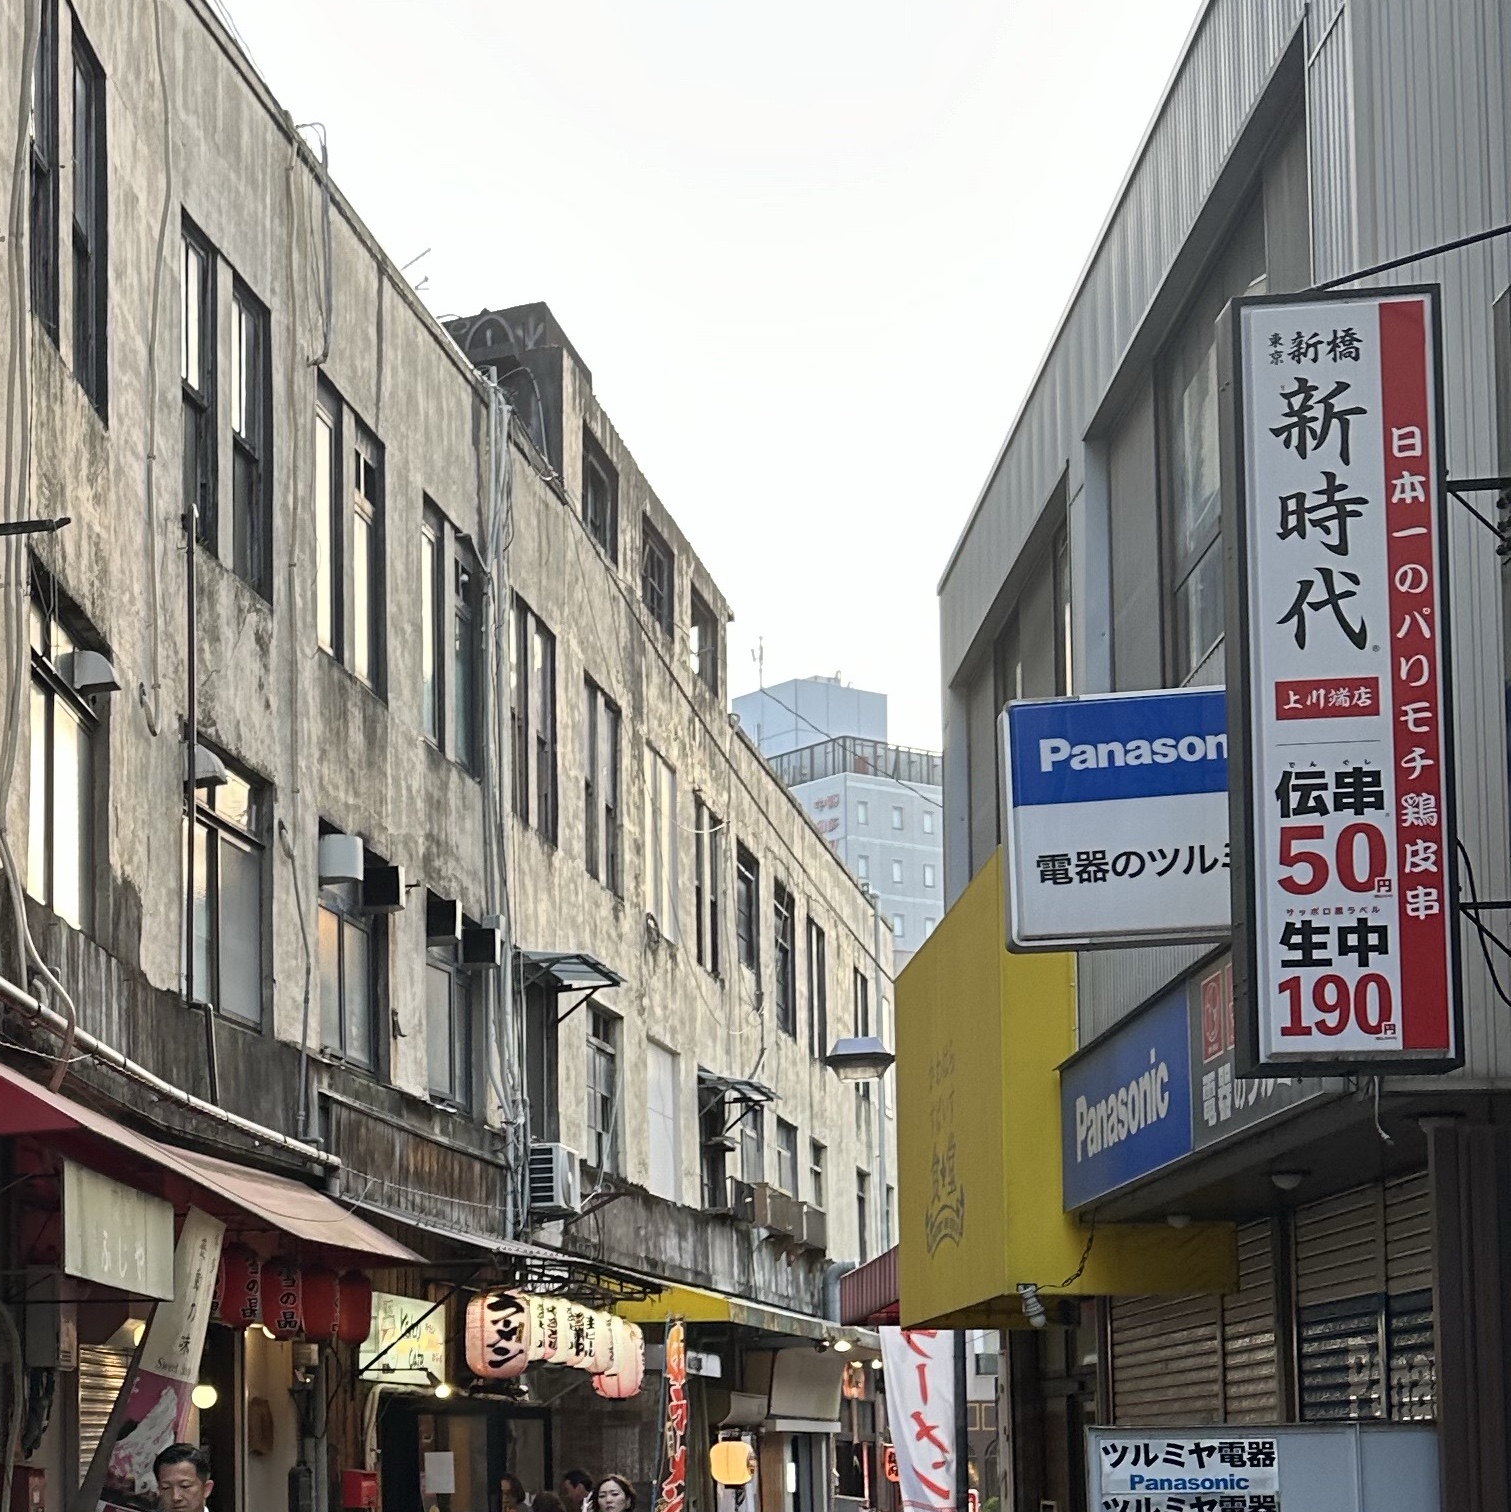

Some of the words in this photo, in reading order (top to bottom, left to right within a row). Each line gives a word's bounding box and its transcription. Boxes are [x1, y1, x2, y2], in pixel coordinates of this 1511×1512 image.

[1268, 332, 1284, 366] 東京
[1287, 327, 1363, 364] 新橋
[1268, 376, 1370, 651] 新時代
[1283, 686, 1373, 709] 上川端店
[1275, 766, 1384, 818] 伝串
[1036, 843, 1231, 886] 電器のツル
[1277, 823, 1392, 896] 50円
[1279, 917, 1389, 968] 生中
[1278, 973, 1396, 1036] 190円
[1075, 1047, 1169, 1163] Panasonic
[1101, 1440, 1276, 1470] ツルミヤ電器
[1129, 1474, 1250, 1491] Panasonic
